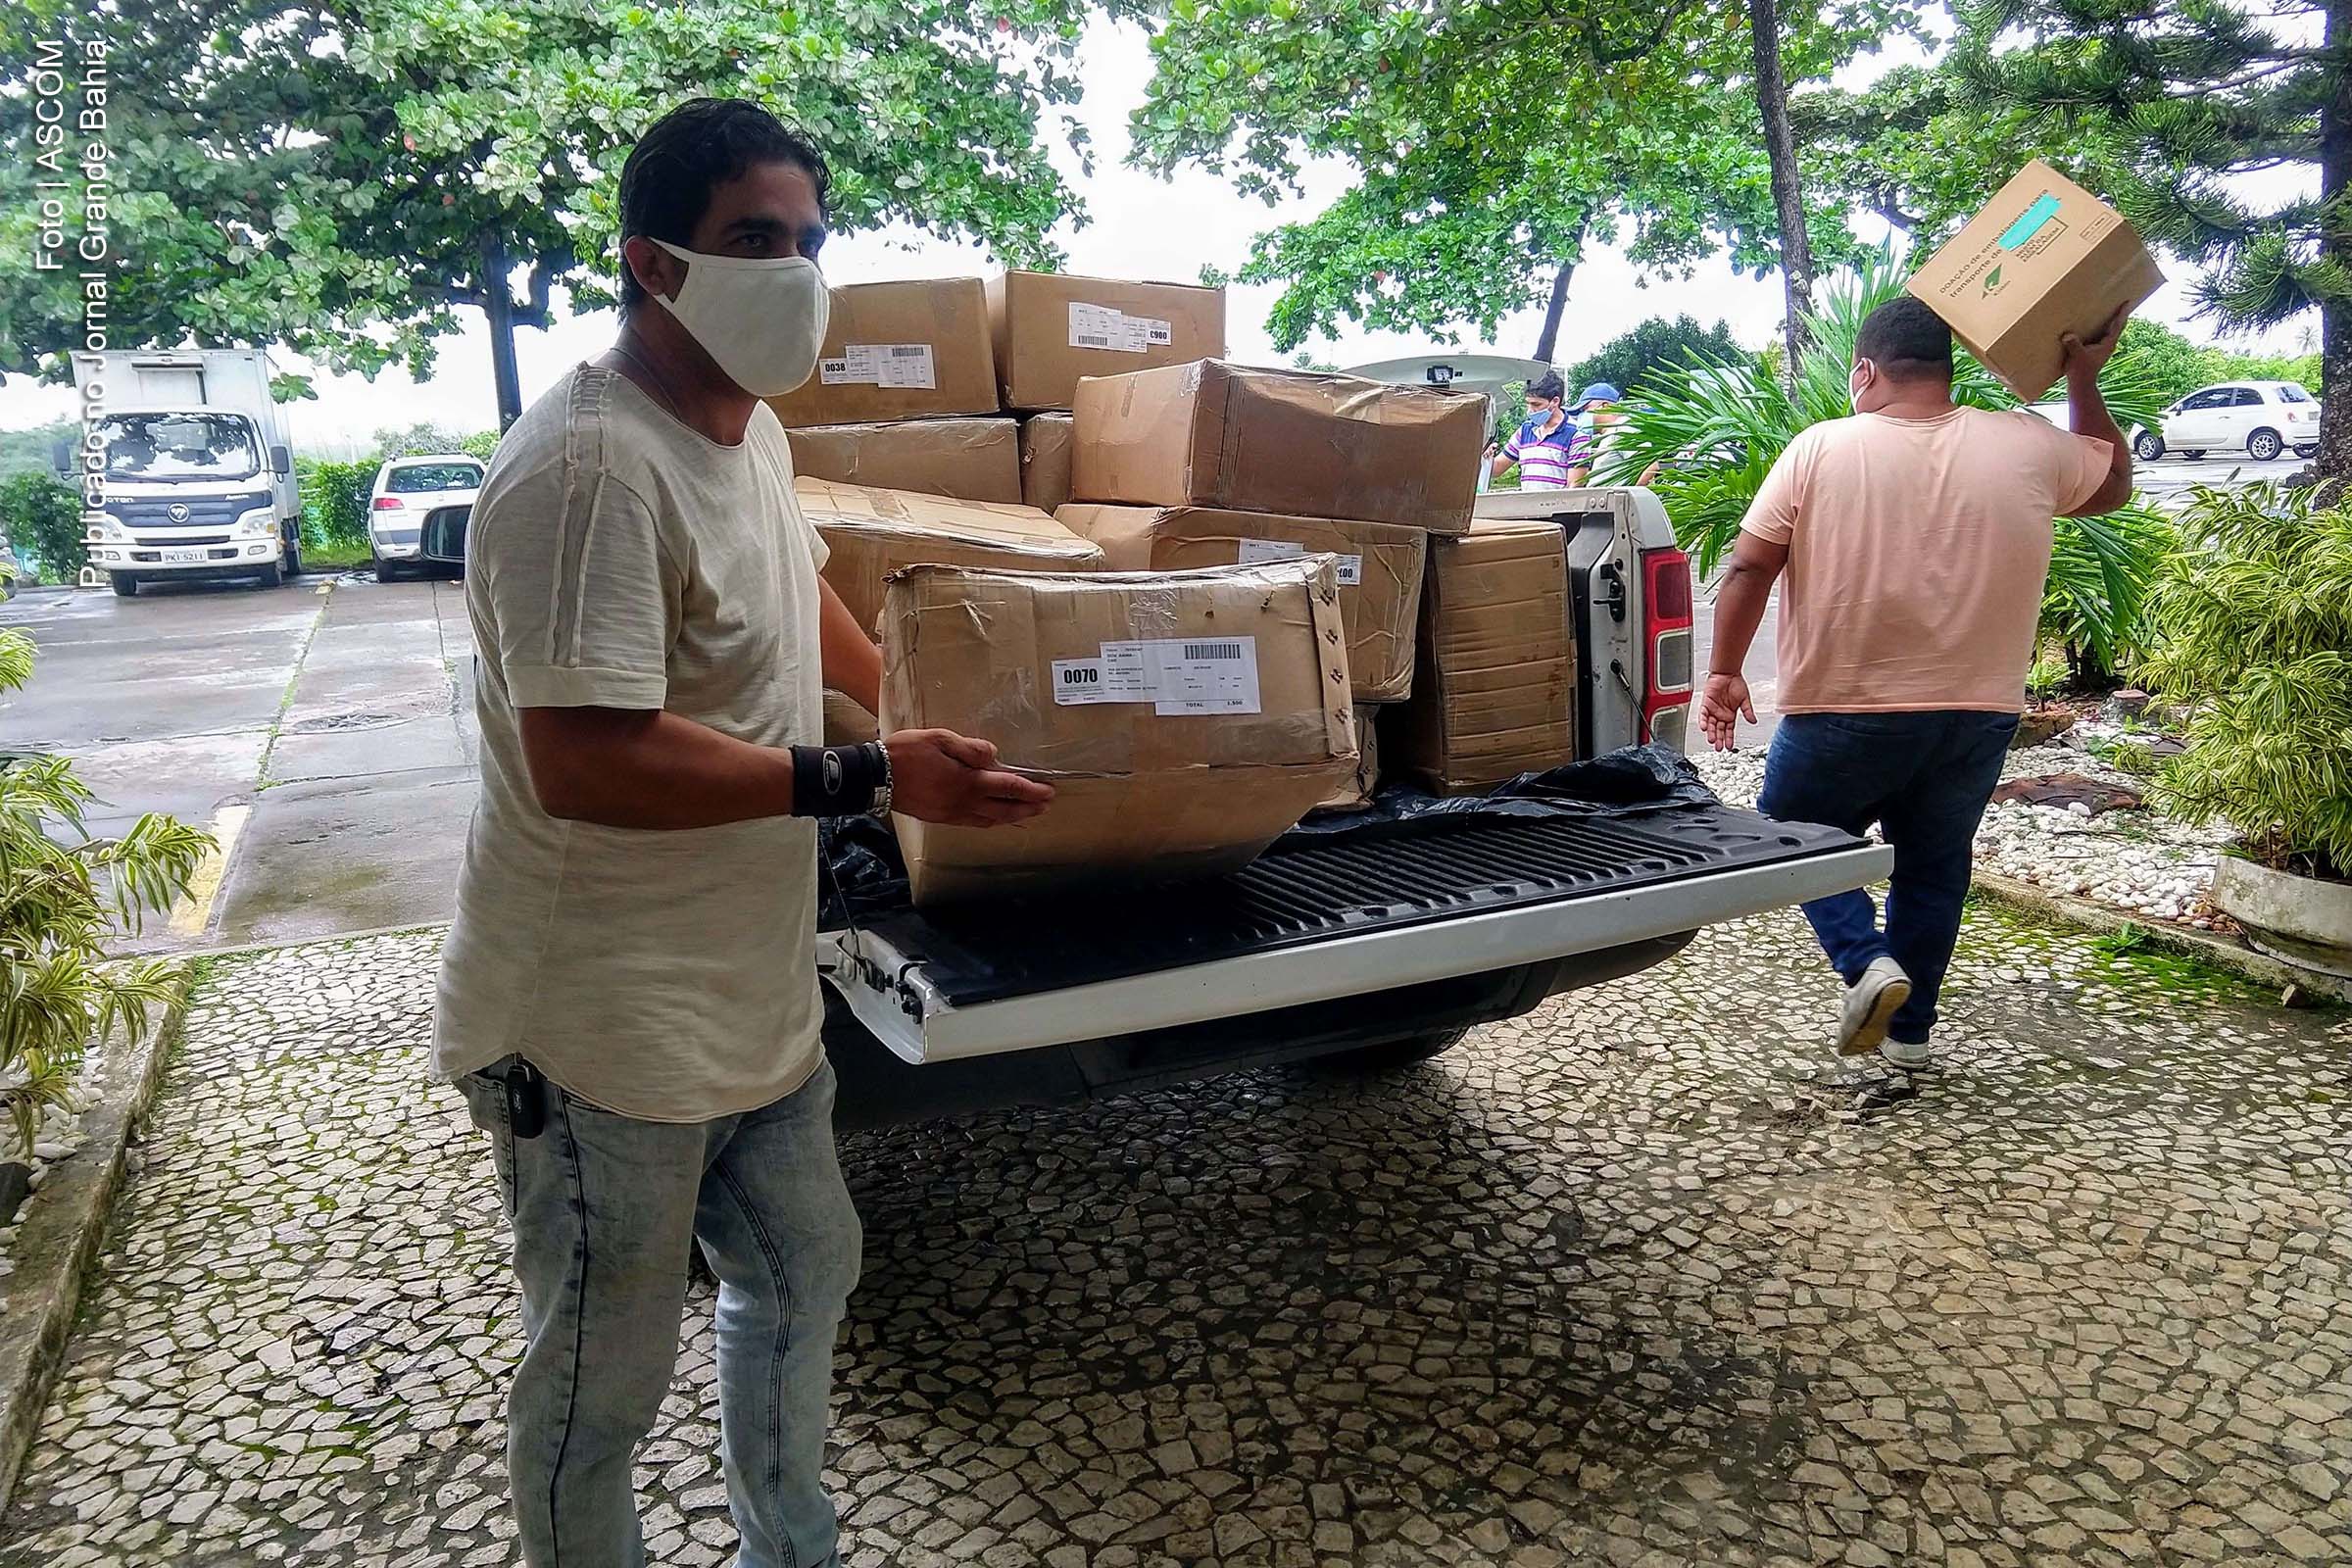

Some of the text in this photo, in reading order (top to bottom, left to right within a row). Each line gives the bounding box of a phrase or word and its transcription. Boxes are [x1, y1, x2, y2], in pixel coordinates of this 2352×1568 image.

[1939, 264, 1971, 294] DOAÇÃO
[1970, 254, 1981, 268] de
[2030, 189, 2048, 208] para
[1949, 248, 2002, 298] transporte de
[824, 363, 846, 372] 0038
[1337, 567, 1353, 578] 007
[1063, 668, 1099, 684] 0070
